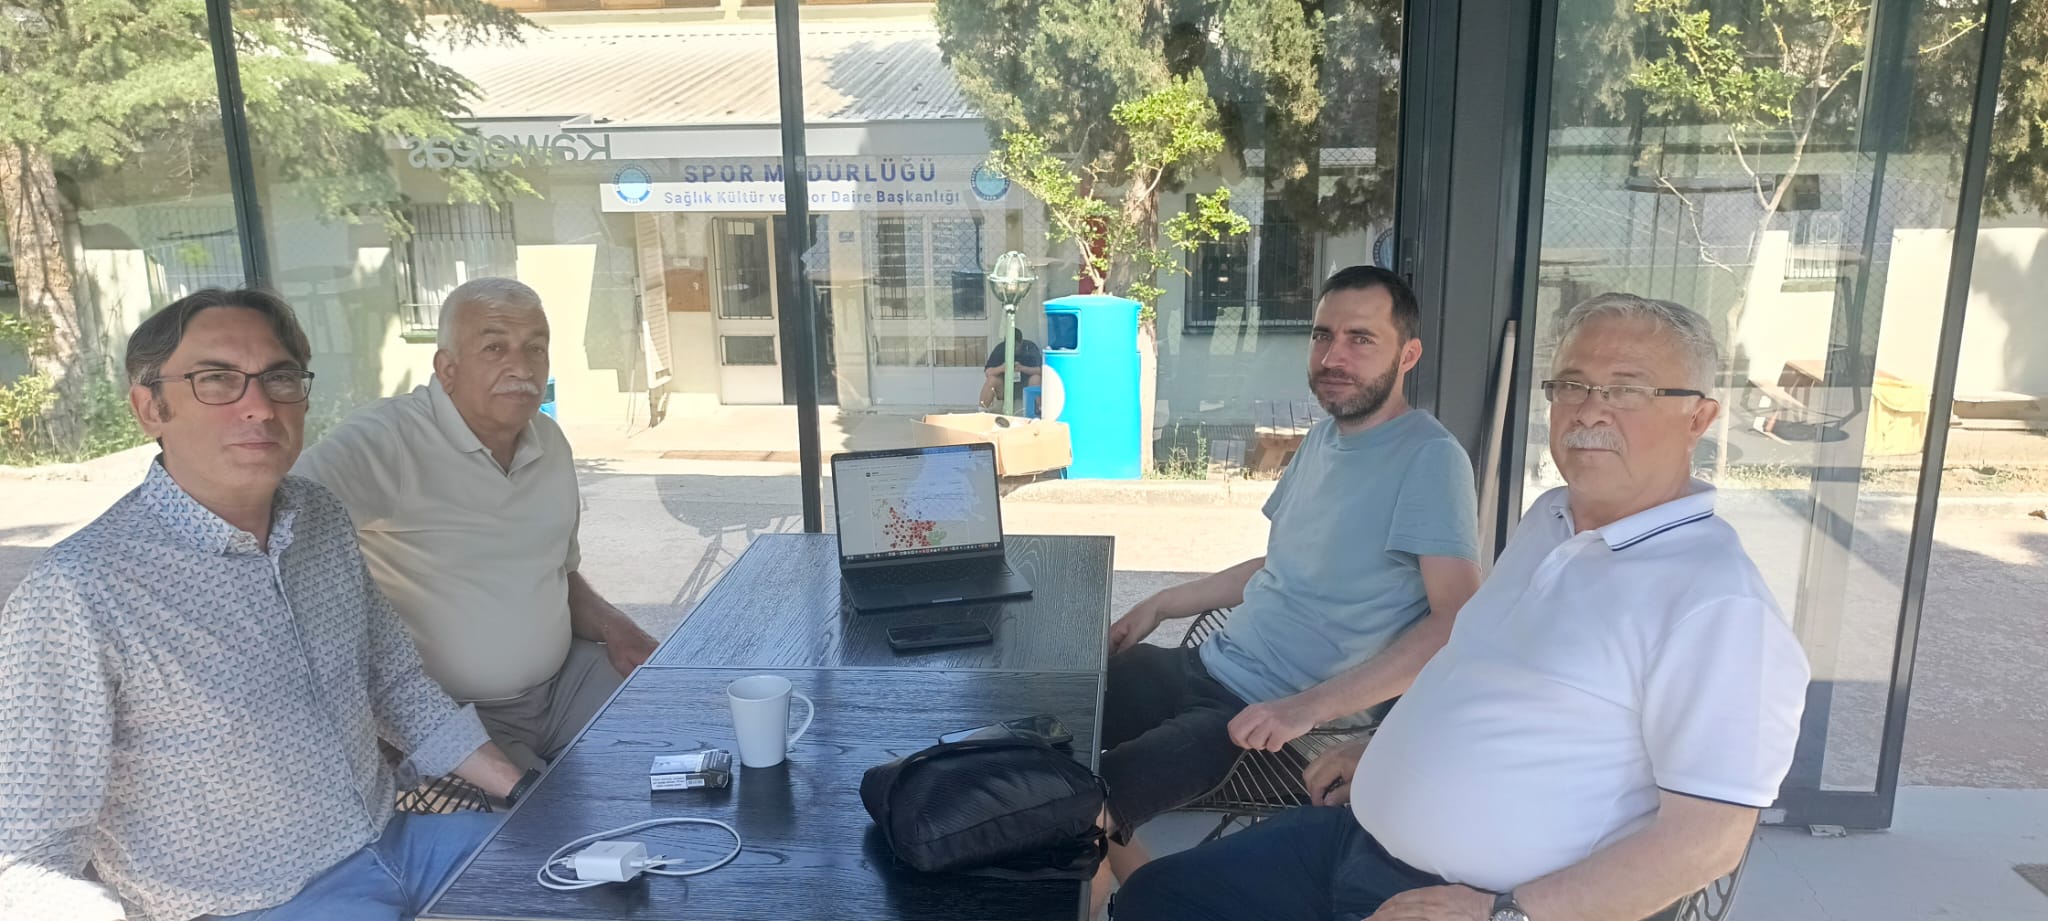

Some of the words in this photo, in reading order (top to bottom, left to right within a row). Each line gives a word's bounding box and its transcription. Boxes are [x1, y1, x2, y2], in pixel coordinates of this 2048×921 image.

[684, 164, 753, 183] SPOR
[763, 158, 935, 182] MDÜRLÜĞÜ
[664, 191, 713, 207] Sağlık
[717, 190, 765, 204] Kültür
[769, 193, 785, 204] ve
[831, 190, 872, 203] Daire
[876, 189, 959, 206] Başkanlığı
